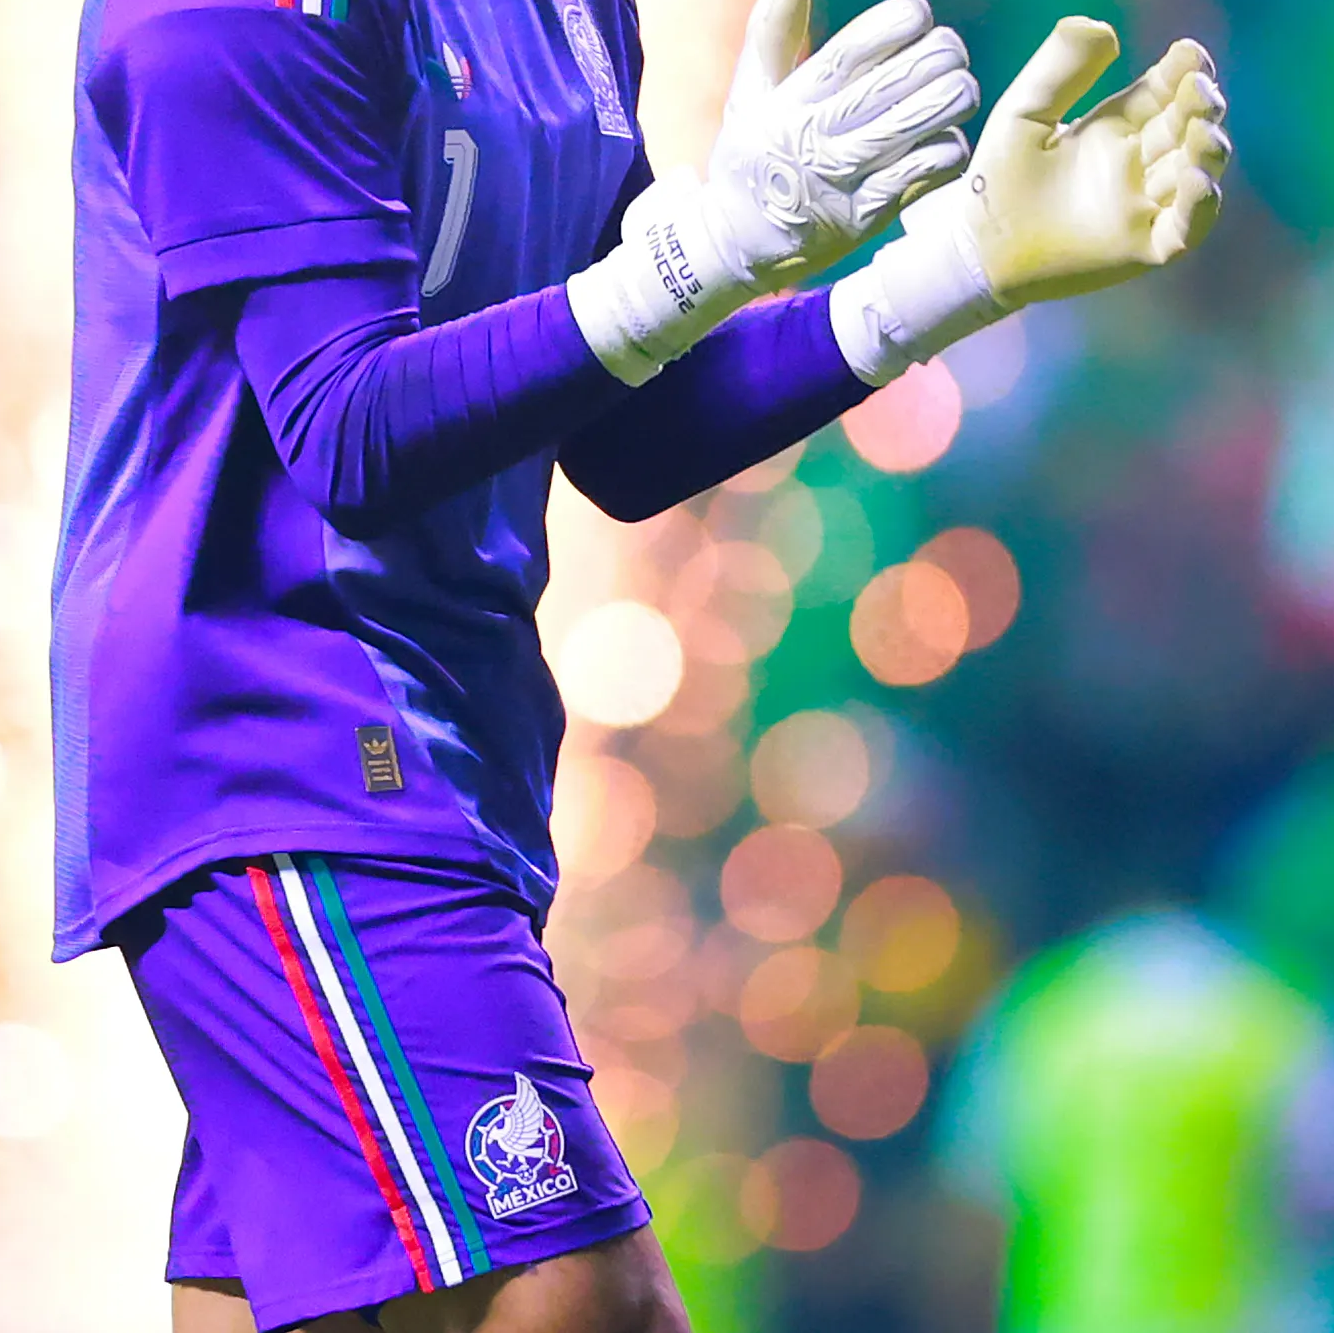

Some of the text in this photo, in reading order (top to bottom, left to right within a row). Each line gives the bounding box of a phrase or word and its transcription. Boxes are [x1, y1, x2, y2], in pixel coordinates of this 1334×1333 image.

[645, 224, 696, 315] VINCERE
[663, 223, 703, 295] NATUS
[493, 1173, 571, 1214] MÉXICO
